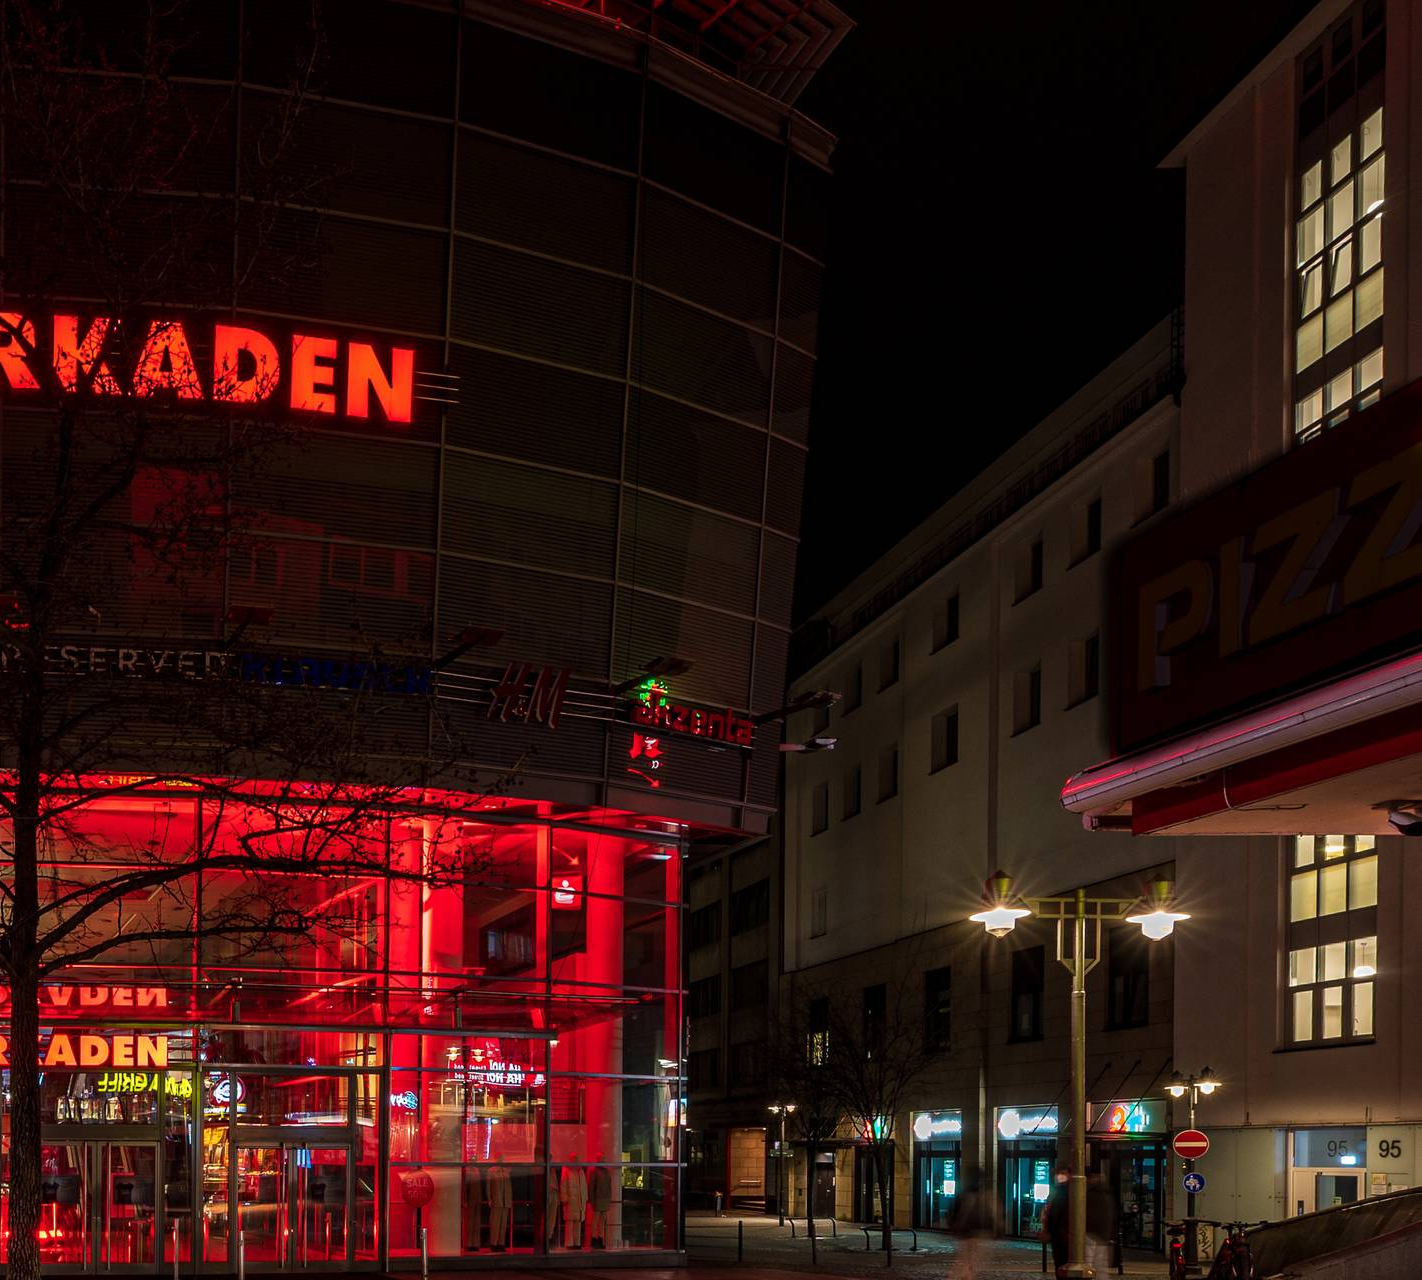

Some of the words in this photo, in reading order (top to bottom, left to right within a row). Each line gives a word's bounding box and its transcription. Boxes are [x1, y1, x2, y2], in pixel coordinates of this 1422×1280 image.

[0, 643, 228, 677] RSERVED
[1327, 1140, 1348, 1158] 95
[1378, 1140, 1402, 1158] 95
[406, 1178, 430, 1189] SALE
